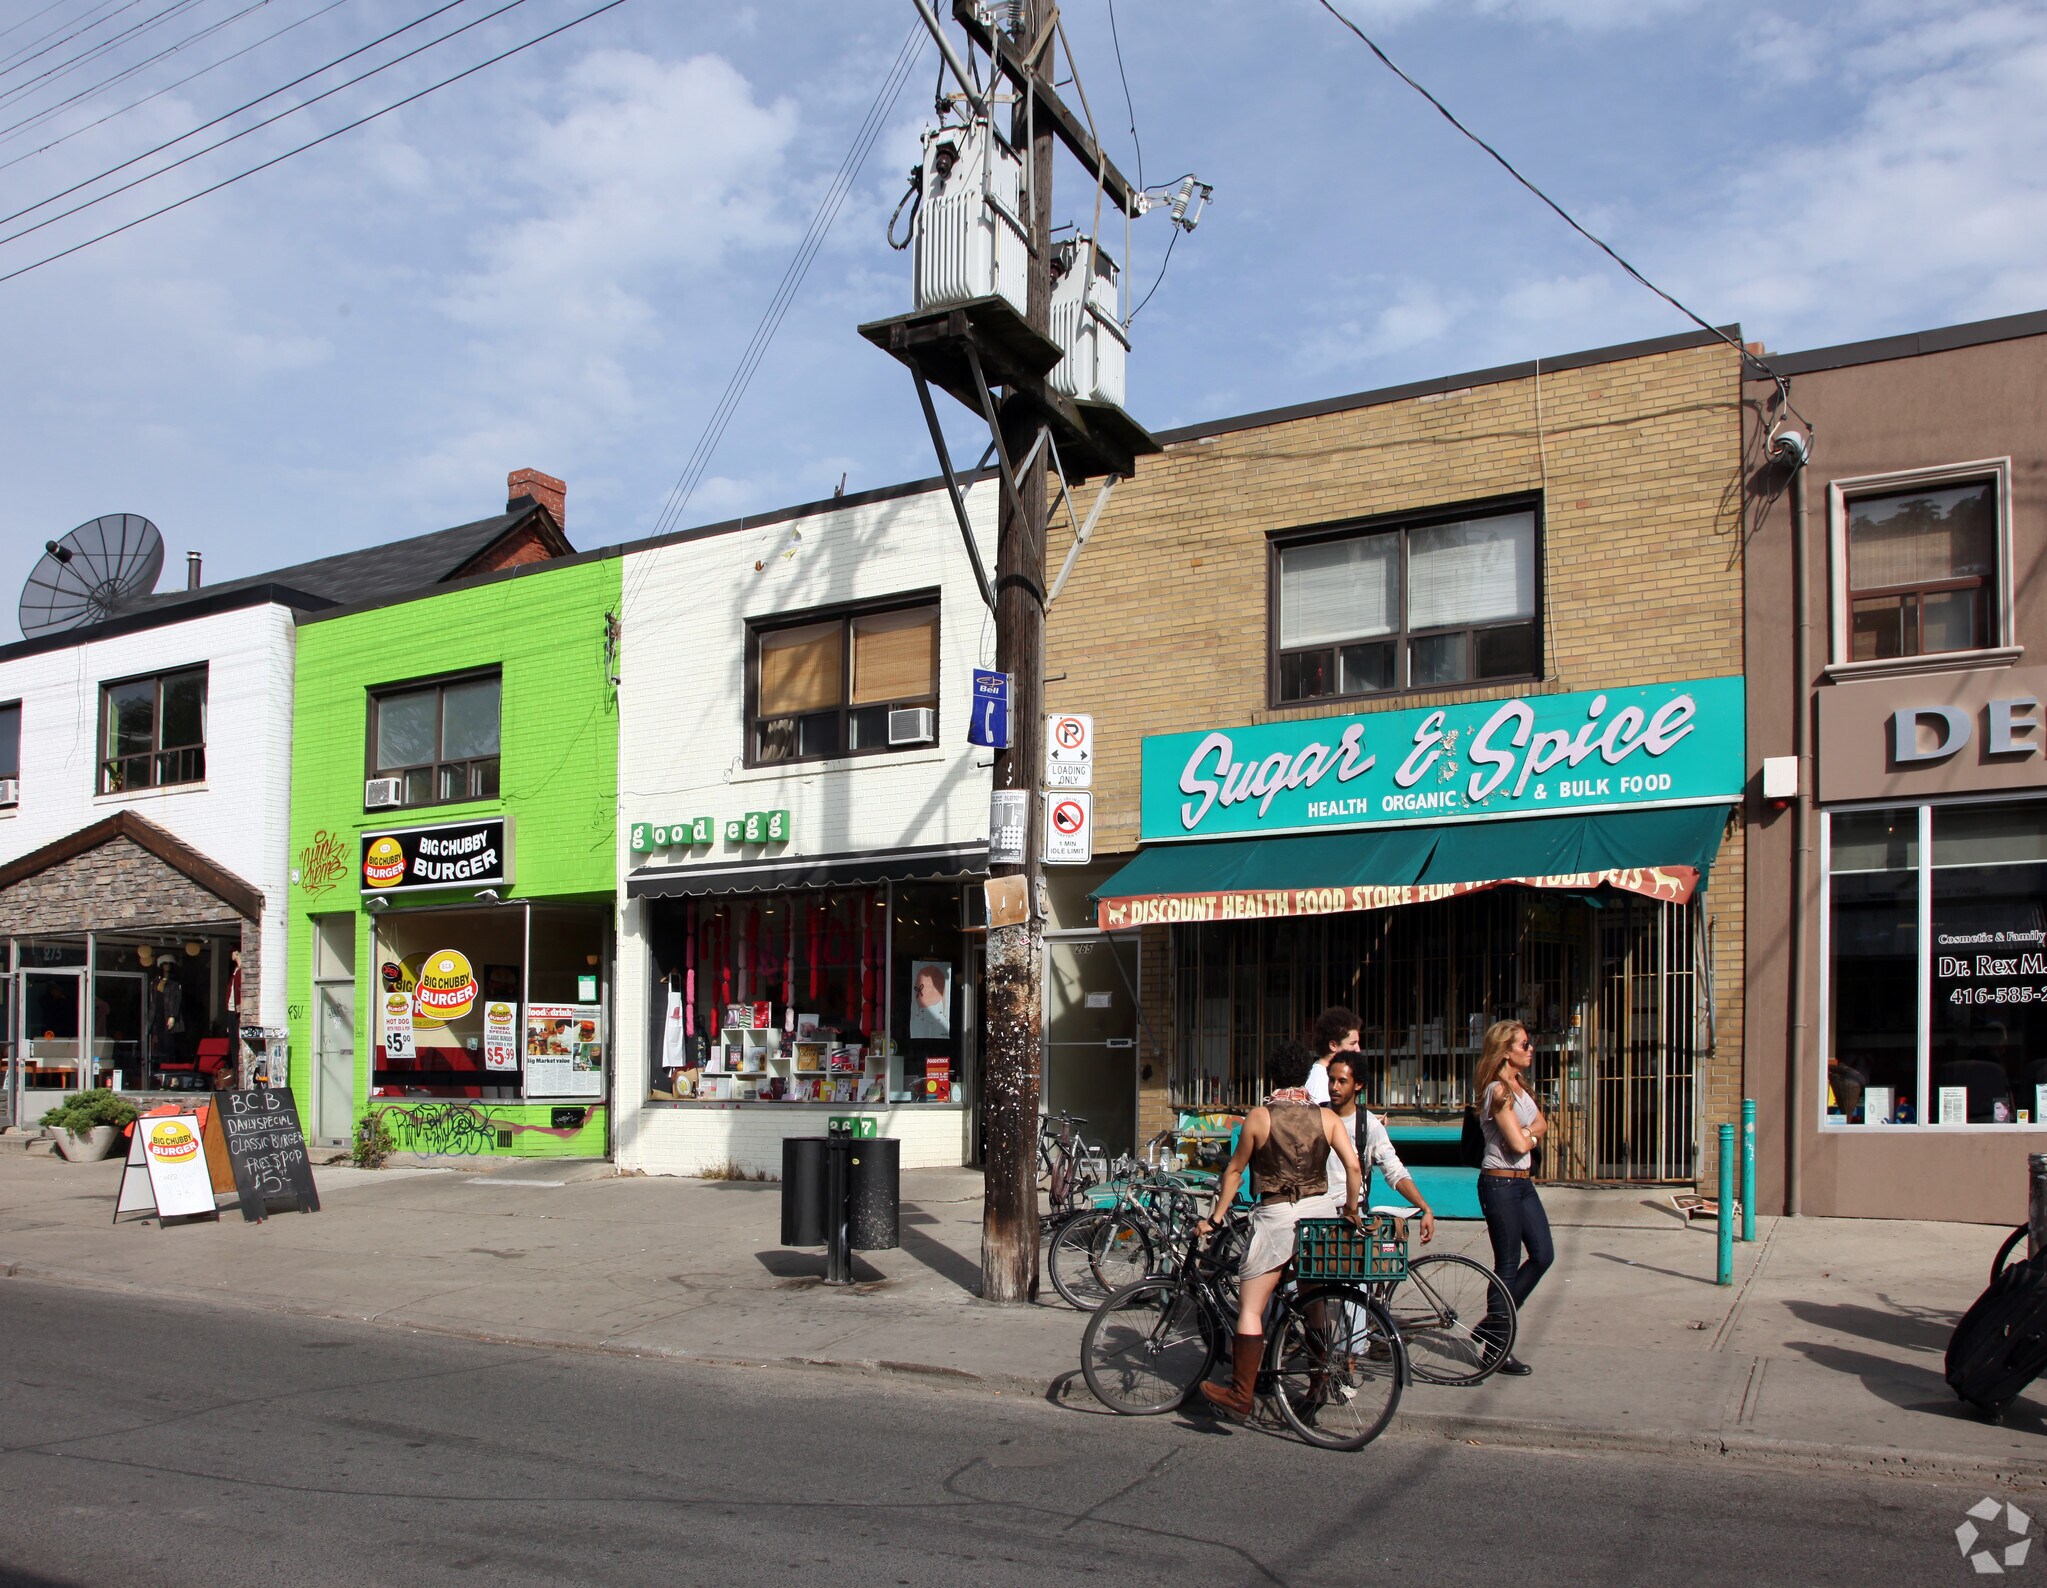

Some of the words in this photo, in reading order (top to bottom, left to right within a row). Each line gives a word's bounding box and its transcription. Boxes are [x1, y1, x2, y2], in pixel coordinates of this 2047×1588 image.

[980, 685, 999, 694] Bell
[1178, 722, 1376, 830] Sugar
[1395, 710, 1446, 788] &
[1467, 693, 1697, 802] Spice
[1052, 765, 1086, 775] LOADING
[1060, 776, 1079, 785] ONLY
[1307, 798, 1367, 818] HEALTH
[1382, 790, 1456, 812] ORGANIC
[1534, 783, 1547, 800] &
[1559, 778, 1609, 798] BULK
[1620, 773, 1671, 794] FOOD
[632, 819, 706, 849] good
[727, 812, 782, 840] egg
[418, 836, 439, 856] BIG
[440, 829, 488, 857] CHUBBY
[368, 855, 379, 866] BIG
[379, 851, 402, 866] CHUBBY
[412, 847, 498, 880] BURGER
[366, 861, 405, 879] BURGER
[1130, 895, 1217, 925] DISCOUNT
[1222, 891, 1289, 919] HEALTH
[1296, 887, 1346, 914] FOOD
[1352, 884, 1415, 910] STORE
[1938, 932, 1993, 945] Cosmetic
[1994, 932, 2005, 942] &
[2006, 930, 2047, 944] Family
[43, 946, 63, 961] 273
[1074, 944, 1094, 955] 265
[382, 966, 399, 978] OPEN
[1938, 956, 1971, 977] Dr.
[1976, 955, 2018, 977] Rex
[2020, 953, 2047, 975] M.
[424, 974, 437, 989] BIG
[438, 972, 470, 989] CHUBBY
[420, 985, 474, 1006] BURGER
[387, 1005, 408, 1013] BURGER
[489, 1014, 512, 1022] BURGER
[487, 1046, 515, 1066] $5.99
[257, 1114, 293, 1130] SPECIAL
[153, 1136, 165, 1144] BIG
[165, 1133, 192, 1145] CHUBBY
[231, 1137, 268, 1155] CLASSIC
[270, 1131, 305, 1149] BURGER
[152, 1141, 197, 1156] BURGER
